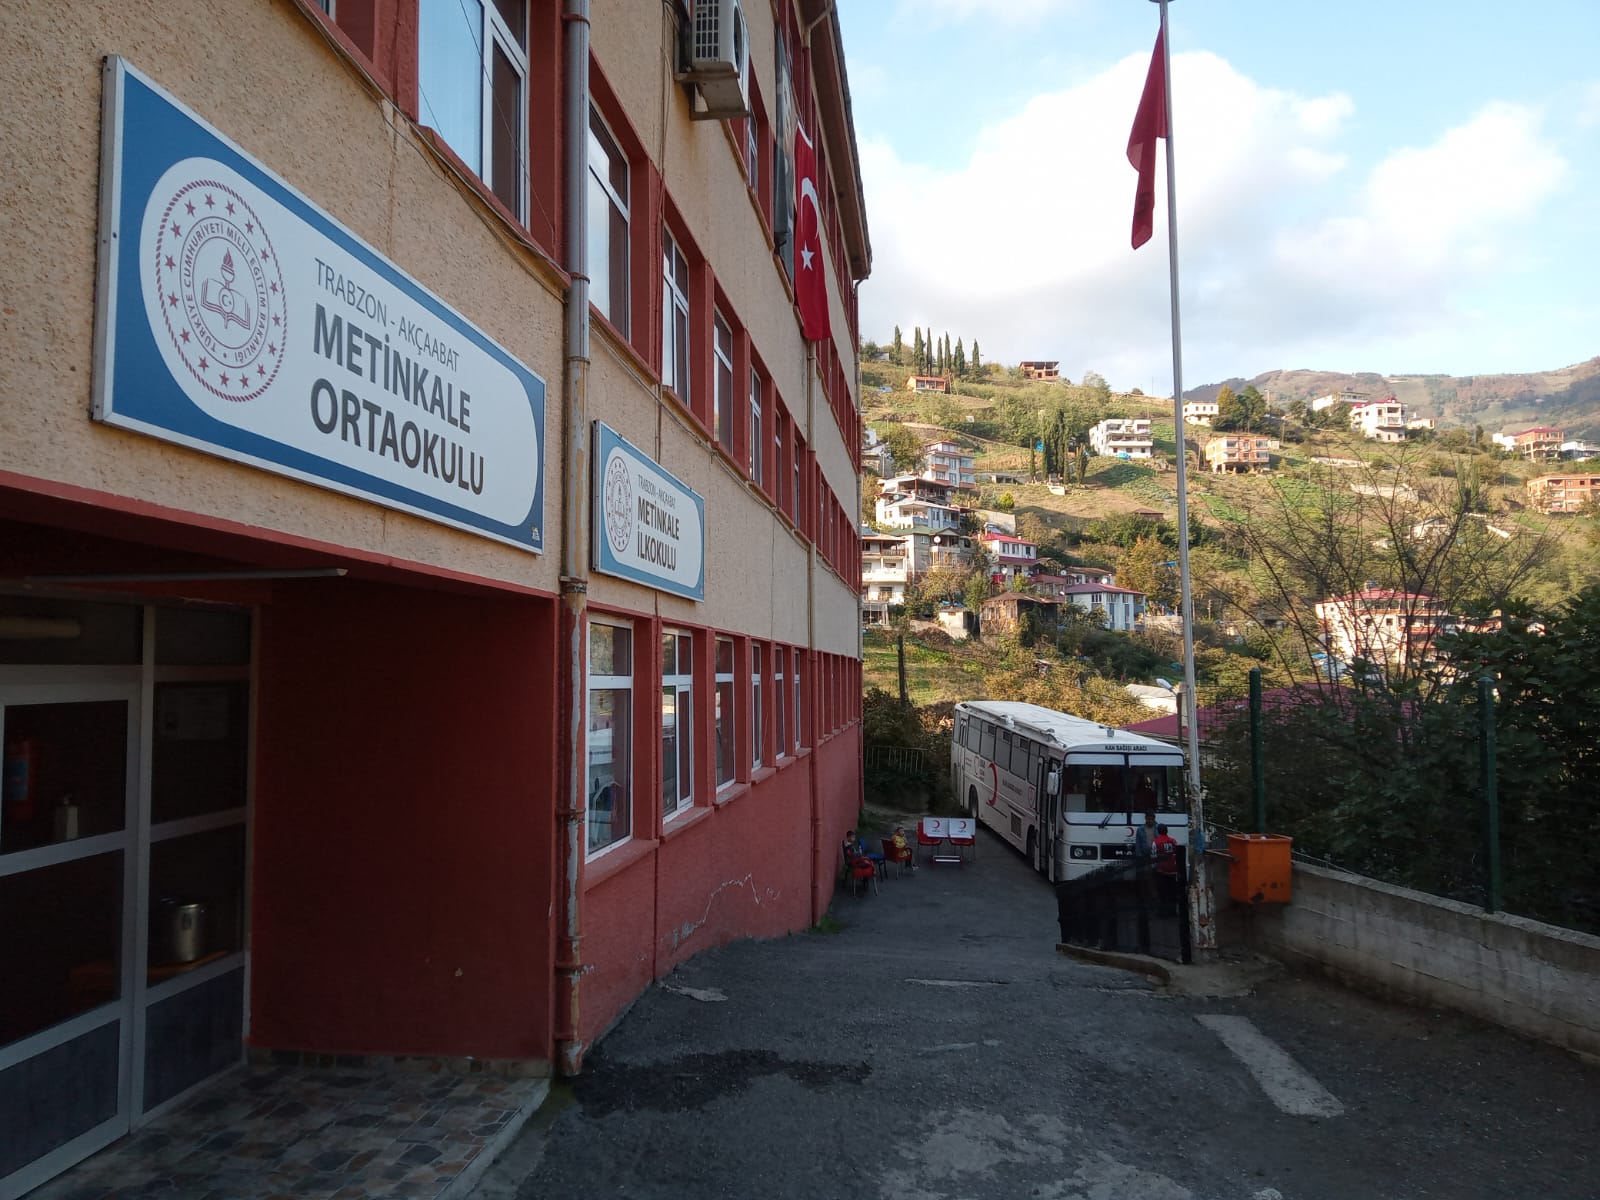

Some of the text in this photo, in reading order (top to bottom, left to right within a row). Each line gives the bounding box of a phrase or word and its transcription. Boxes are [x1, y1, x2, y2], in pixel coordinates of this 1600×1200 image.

[313, 302, 472, 434] METİNKALE
[314, 257, 388, 327] TRABZON
[398, 319, 461, 374] AKÇAABAT
[310, 378, 485, 496] ORTAOKULU
[637, 496, 679, 540] METİNKALE
[637, 524, 676, 571] İLKOKULU
